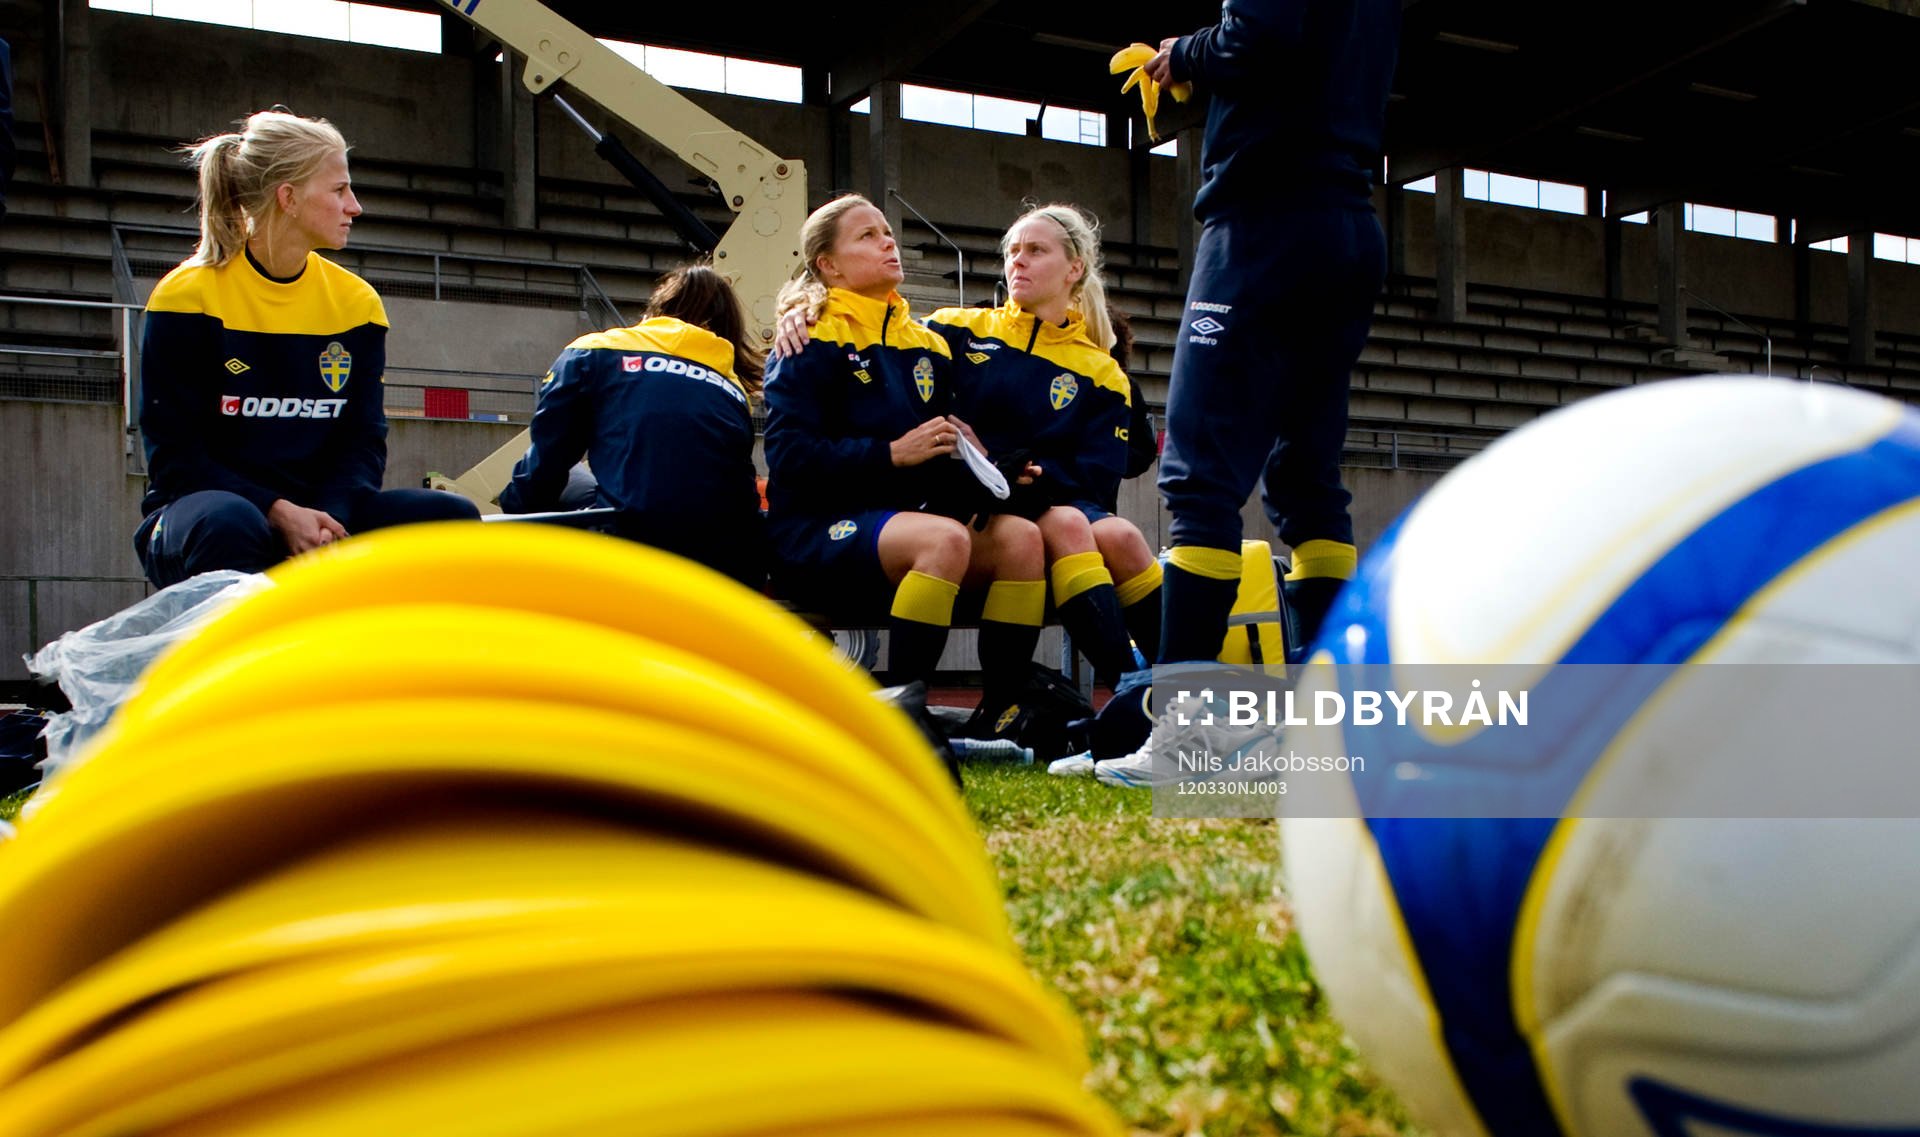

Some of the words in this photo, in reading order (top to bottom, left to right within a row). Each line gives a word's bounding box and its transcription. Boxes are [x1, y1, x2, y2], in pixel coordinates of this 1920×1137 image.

[1189, 335, 1218, 346] umbro
[644, 356, 746, 402] ODDSET
[241, 397, 348, 418] ODDSET
